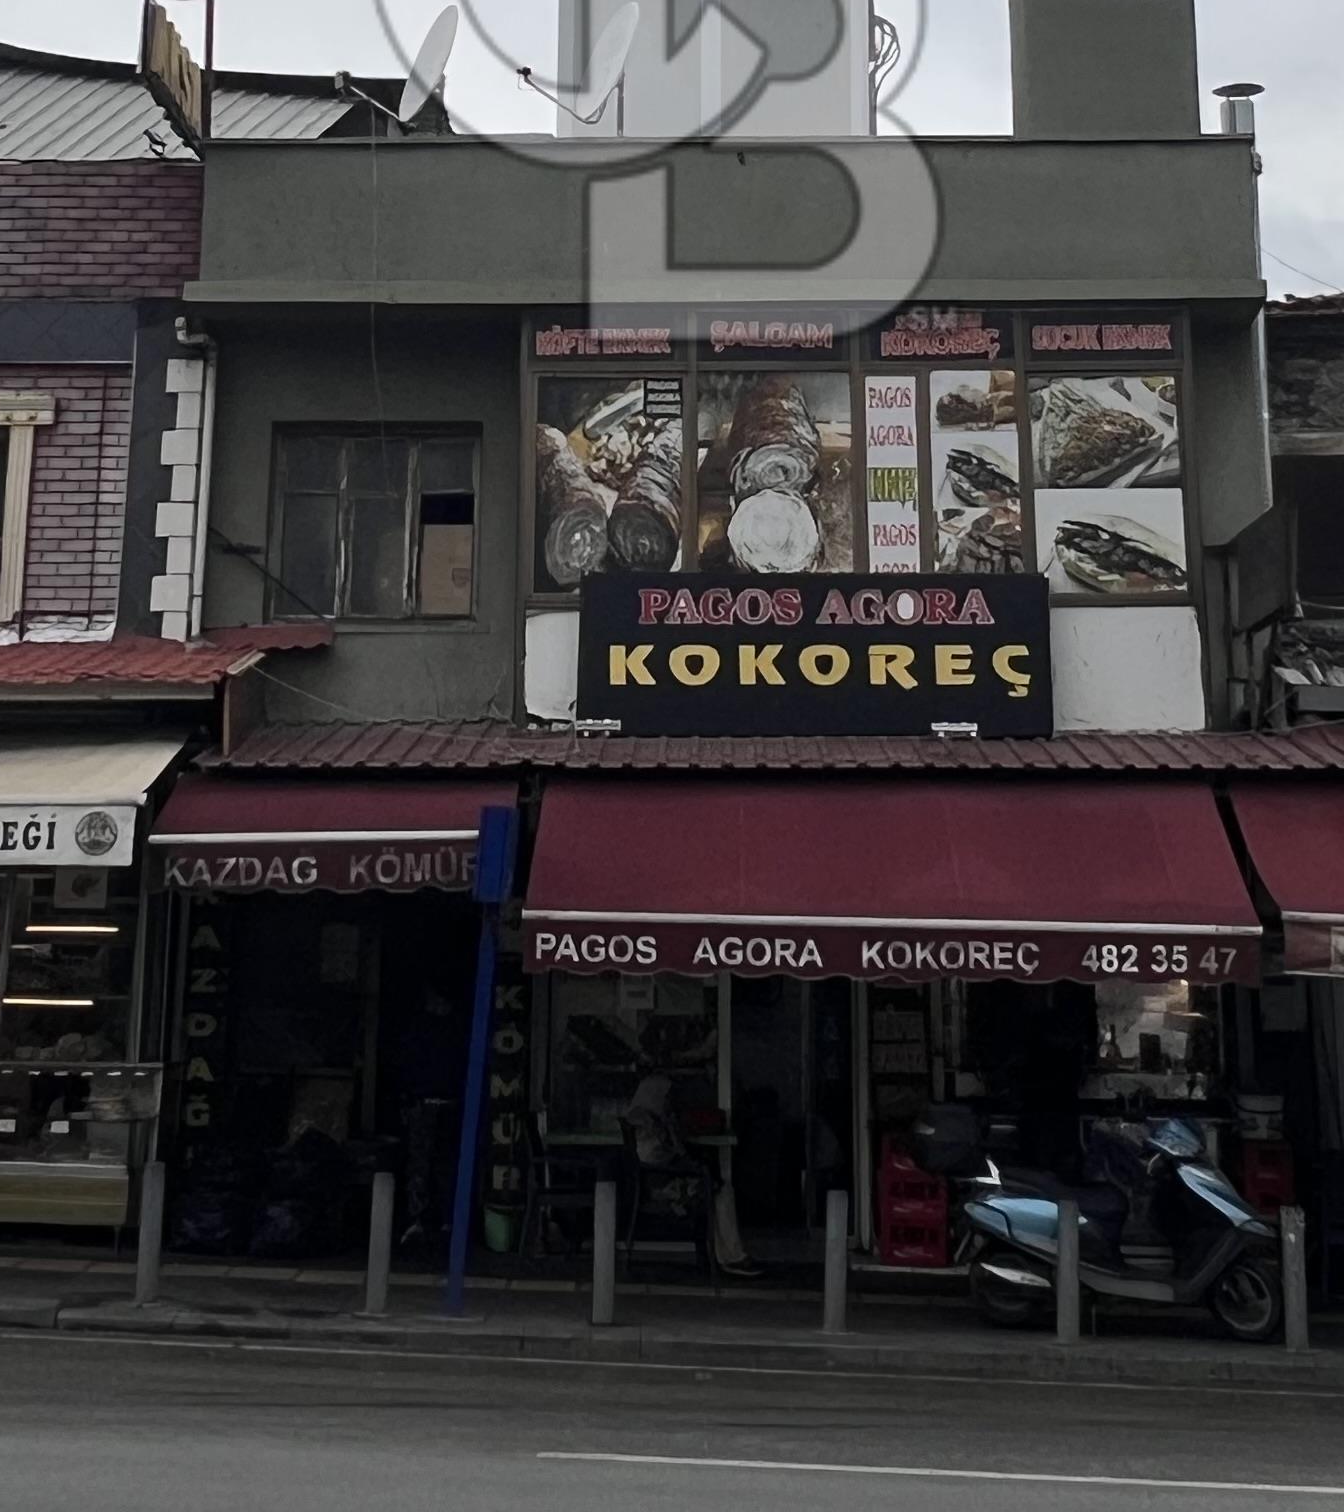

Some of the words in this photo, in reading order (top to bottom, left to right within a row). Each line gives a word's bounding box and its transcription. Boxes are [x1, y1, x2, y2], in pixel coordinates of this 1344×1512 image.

[868, 387, 912, 409] PAGOS
[868, 425, 915, 447] AGORA
[872, 523, 917, 546] PAGOS
[638, 588, 803, 625] PAGOS
[815, 588, 995, 625] AGORA
[609, 644, 1031, 697] KOKOREÇ
[535, 932, 657, 965] PAGOS
[692, 936, 824, 968] AGORA
[861, 940, 1040, 976] KOKOREÇ
[1081, 944, 1140, 973] 482
[1151, 944, 1188, 974] 35
[1198, 947, 1238, 975] 47
